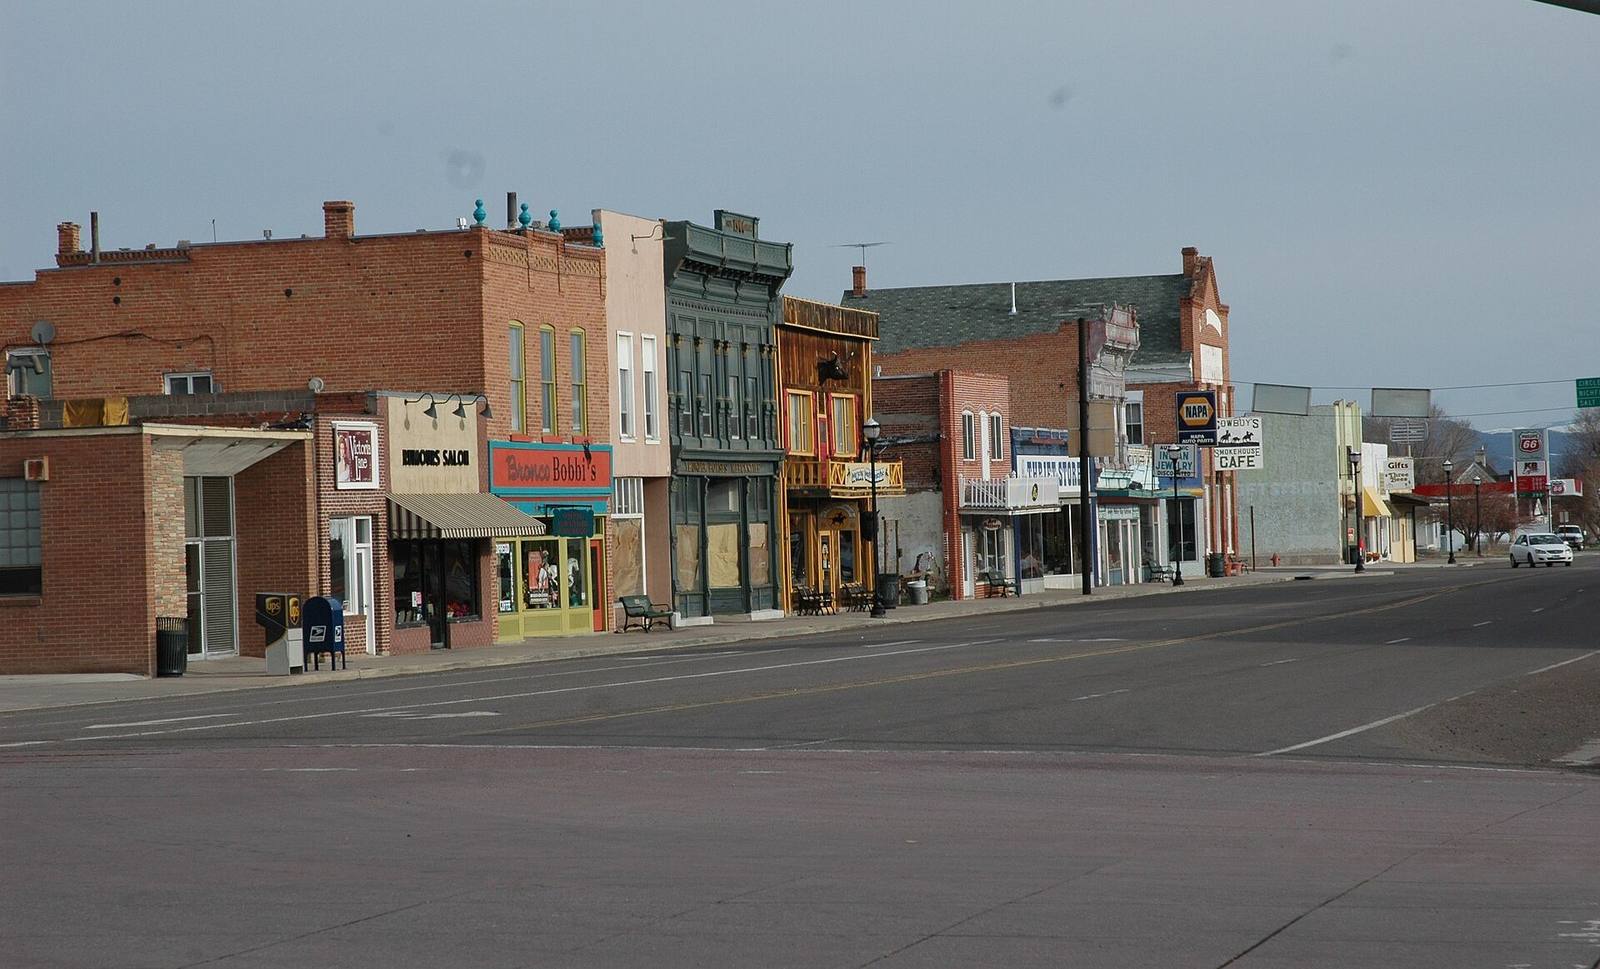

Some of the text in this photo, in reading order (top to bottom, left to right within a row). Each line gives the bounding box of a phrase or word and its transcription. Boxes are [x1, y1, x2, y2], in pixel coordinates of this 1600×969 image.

[1185, 405, 1208, 418] NAPA
[348, 435, 371, 460] Victoria
[1523, 440, 1538, 449] 66
[442, 449, 470, 466] SALON
[1159, 451, 1189, 461] INAN
[1214, 447, 1260, 458] SMOKEHOUSE
[506, 454, 597, 482] Bronco Bobbi's
[1155, 461, 1193, 471] JEWLRY
[1220, 455, 1255, 468] CAFE
[355, 456, 368, 481] Lane
